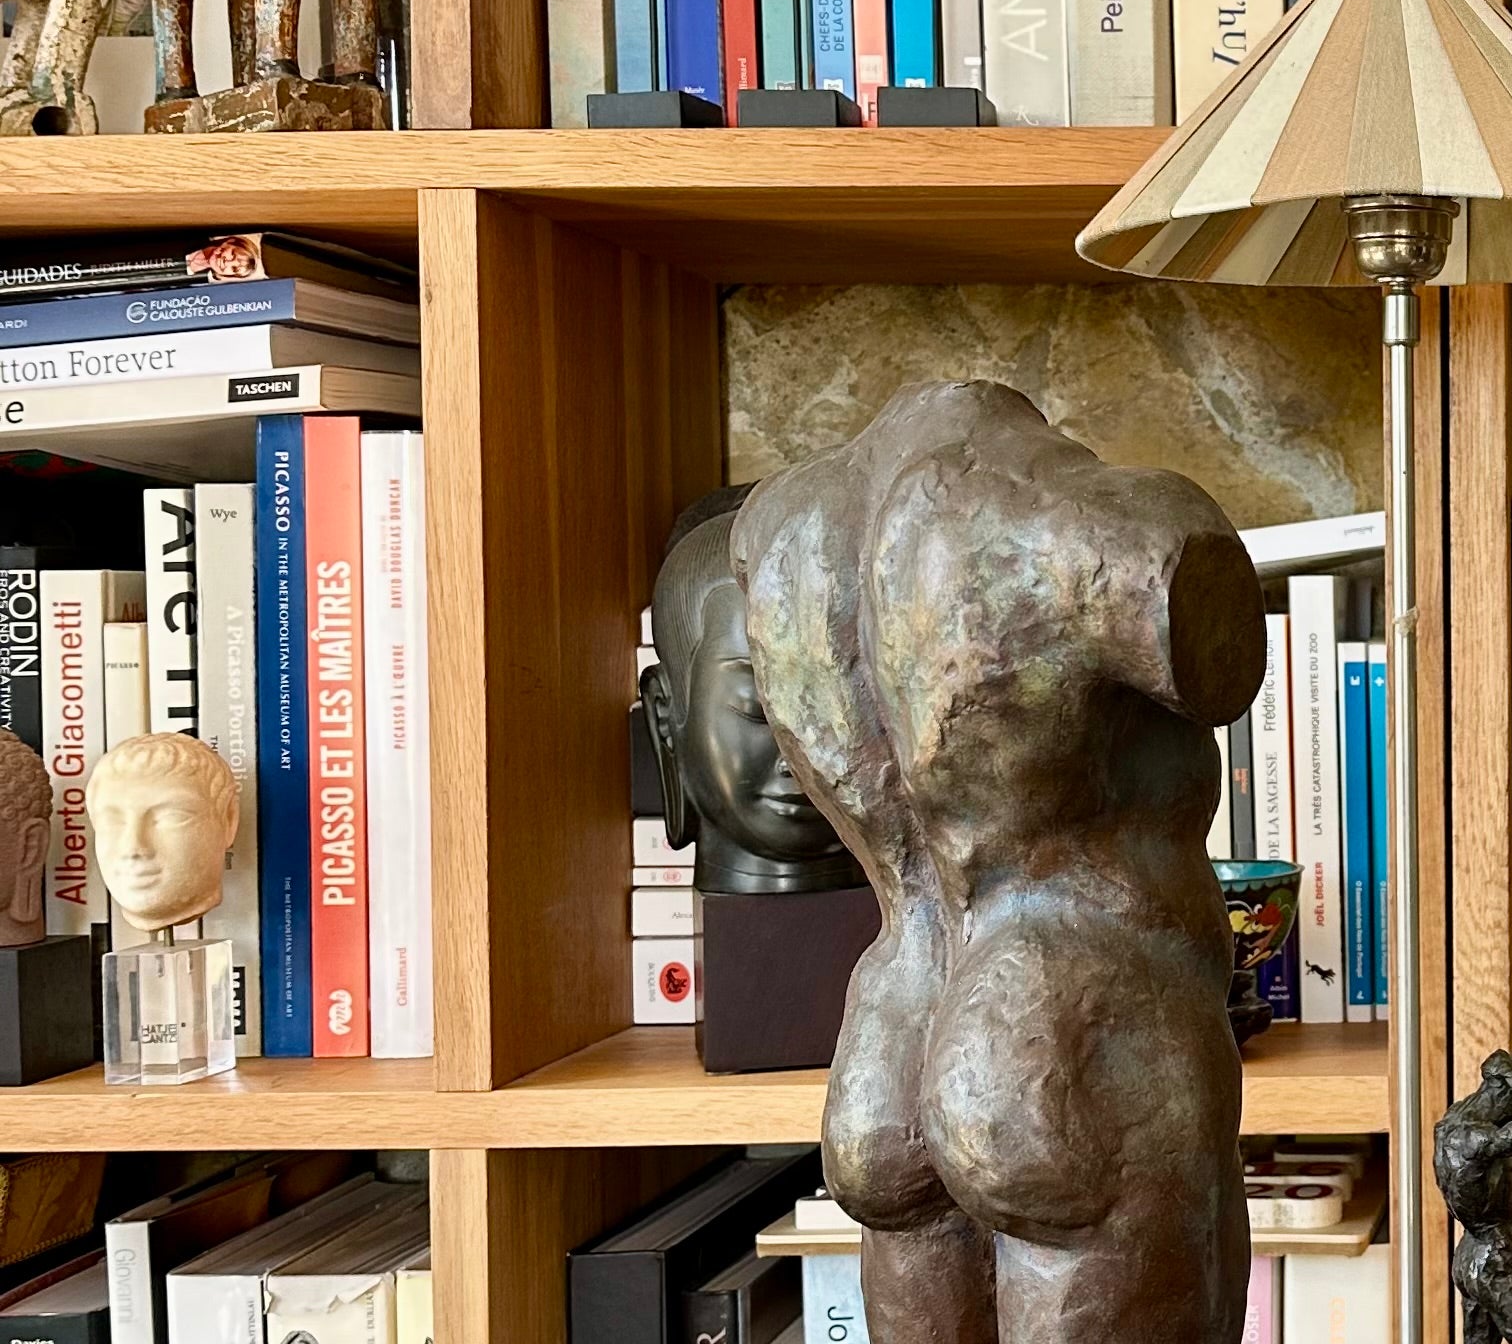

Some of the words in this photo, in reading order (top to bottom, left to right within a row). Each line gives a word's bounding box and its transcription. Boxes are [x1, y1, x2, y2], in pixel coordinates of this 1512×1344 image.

[150, 294, 211, 311] FUNDAÇÃO
[150, 308, 206, 324] CALOUSTE
[204, 298, 273, 324] GULBENKIAN
[68, 346, 178, 379] Forever
[234, 379, 292, 396] TASCHEN
[273, 449, 290, 534] PICASSO
[388, 476, 401, 520] DUNCAN
[208, 506, 239, 523] Wye
[279, 536, 289, 549] IN
[389, 520, 401, 573] DOUGLAS
[279, 549, 290, 572] THE
[389, 574, 402, 610] DAVID
[7, 567, 39, 679] RODIN
[279, 571, 291, 665] METROPOLITAN
[309, 557, 354, 684] MAÎTRES
[1309, 632, 1320, 658] ZOO
[1310, 657, 1320, 672] DU
[52, 600, 86, 779] Giacometti
[280, 666, 292, 724] MUSEUM
[1261, 676, 1277, 733] Frédéric
[1310, 672, 1321, 703] VISITE
[319, 686, 354, 738] LES
[281, 725, 291, 741] OF
[1310, 704, 1323, 796] CATASTROPHIQUE
[280, 743, 292, 771] ART
[321, 740, 356, 777] ET
[1265, 750, 1280, 816] SAGESSE
[1312, 796, 1323, 823] TRÈS
[1267, 817, 1280, 838] LA
[1312, 823, 1323, 836] LA
[54, 786, 88, 908] Alberto
[322, 786, 358, 907] PICASSO
[1268, 838, 1281, 862] DE
[1314, 861, 1326, 899] DICKER
[1315, 900, 1327, 929] JOËL
[395, 945, 408, 1008] Gallimard
[140, 1023, 178, 1036] HATJE
